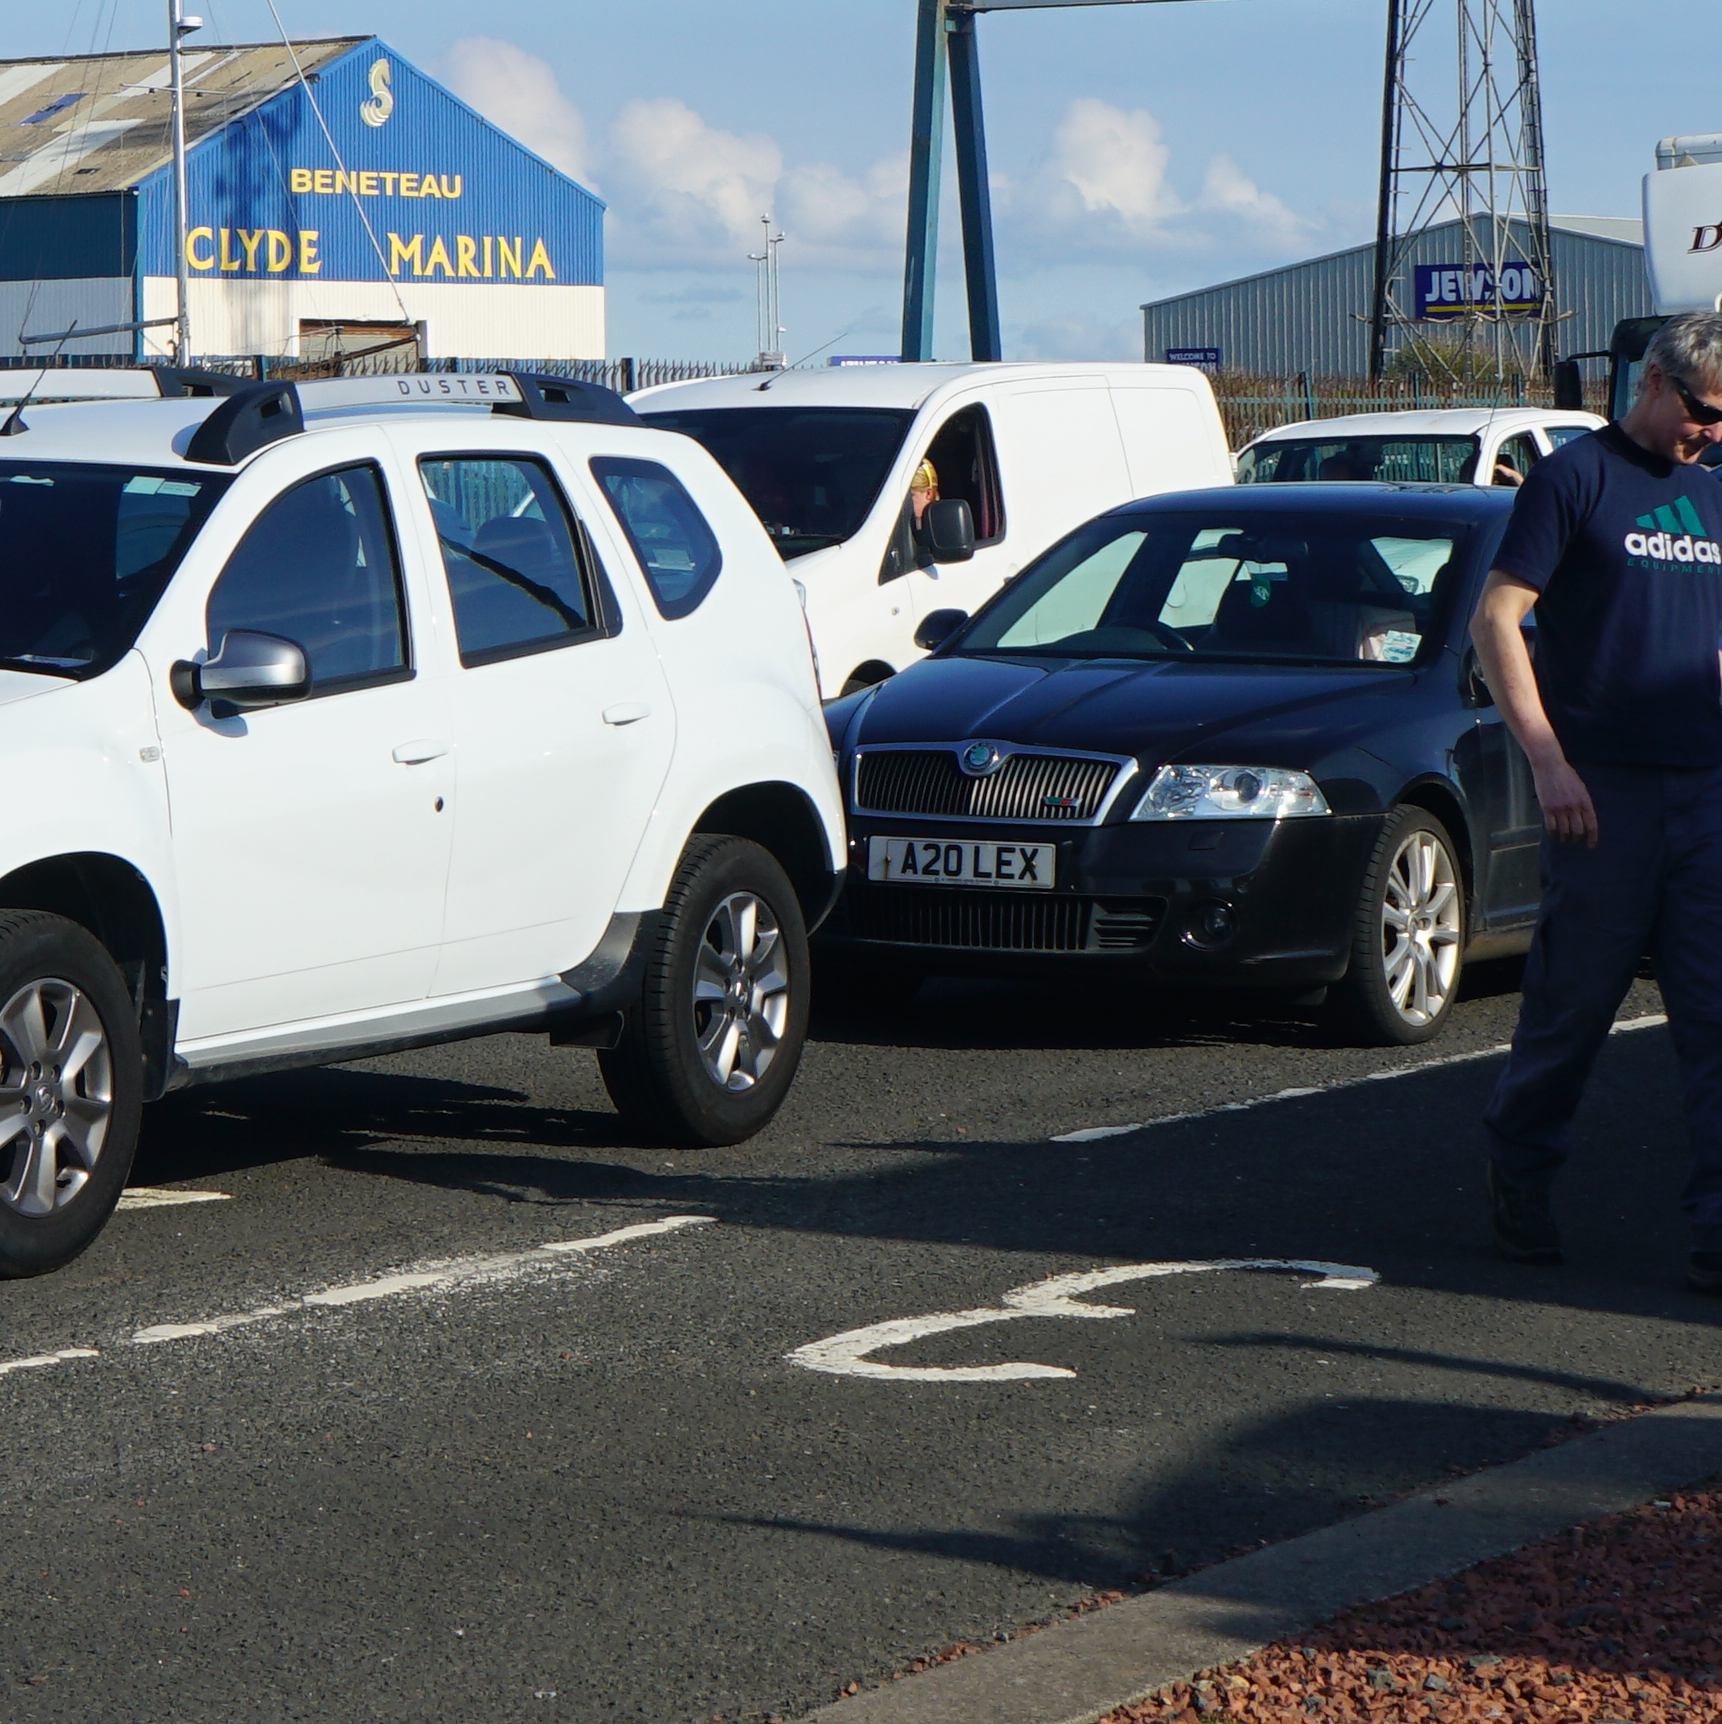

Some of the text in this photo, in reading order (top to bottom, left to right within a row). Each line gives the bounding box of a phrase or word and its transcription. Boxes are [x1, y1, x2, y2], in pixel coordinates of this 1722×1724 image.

[291, 168, 462, 199] BENETEAU
[185, 226, 556, 279] CLYDE MARINA
[1169, 352, 1216, 361] WELCOME TO
[397, 378, 511, 396] DUSTER
[1624, 532, 1722, 565] adidas
[1627, 557, 1722, 575] EQUIPMENT
[900, 842, 1040, 881] A20 LEX
